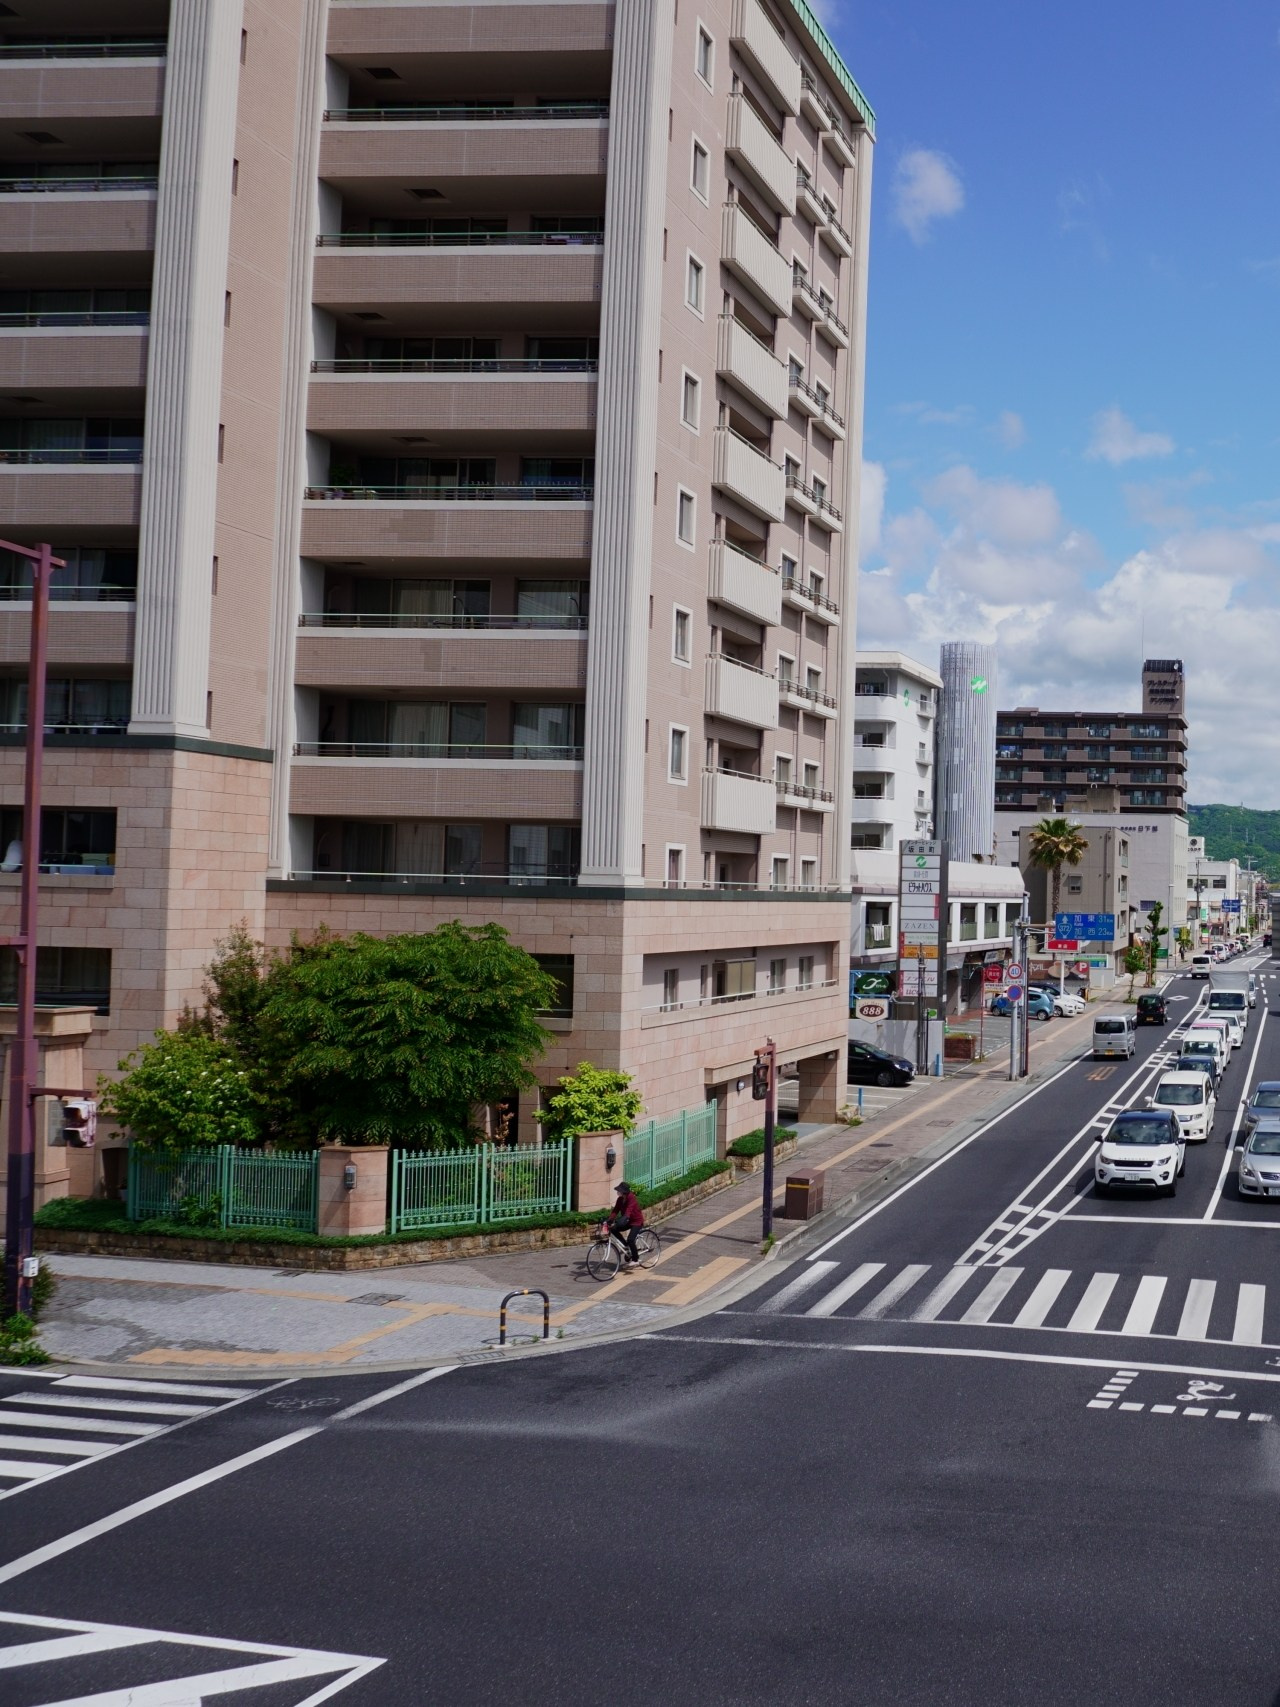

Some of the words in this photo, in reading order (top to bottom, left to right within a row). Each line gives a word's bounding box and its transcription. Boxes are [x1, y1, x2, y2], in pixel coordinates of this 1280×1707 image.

[1074, 914, 1095, 923] 加東
[904, 922, 935, 930] ZAZEN
[1074, 927, 1096, 936] 加西
[1010, 967, 1019, 976] 40
[1079, 962, 1087, 972] P
[862, 1006, 882, 1015] 888
